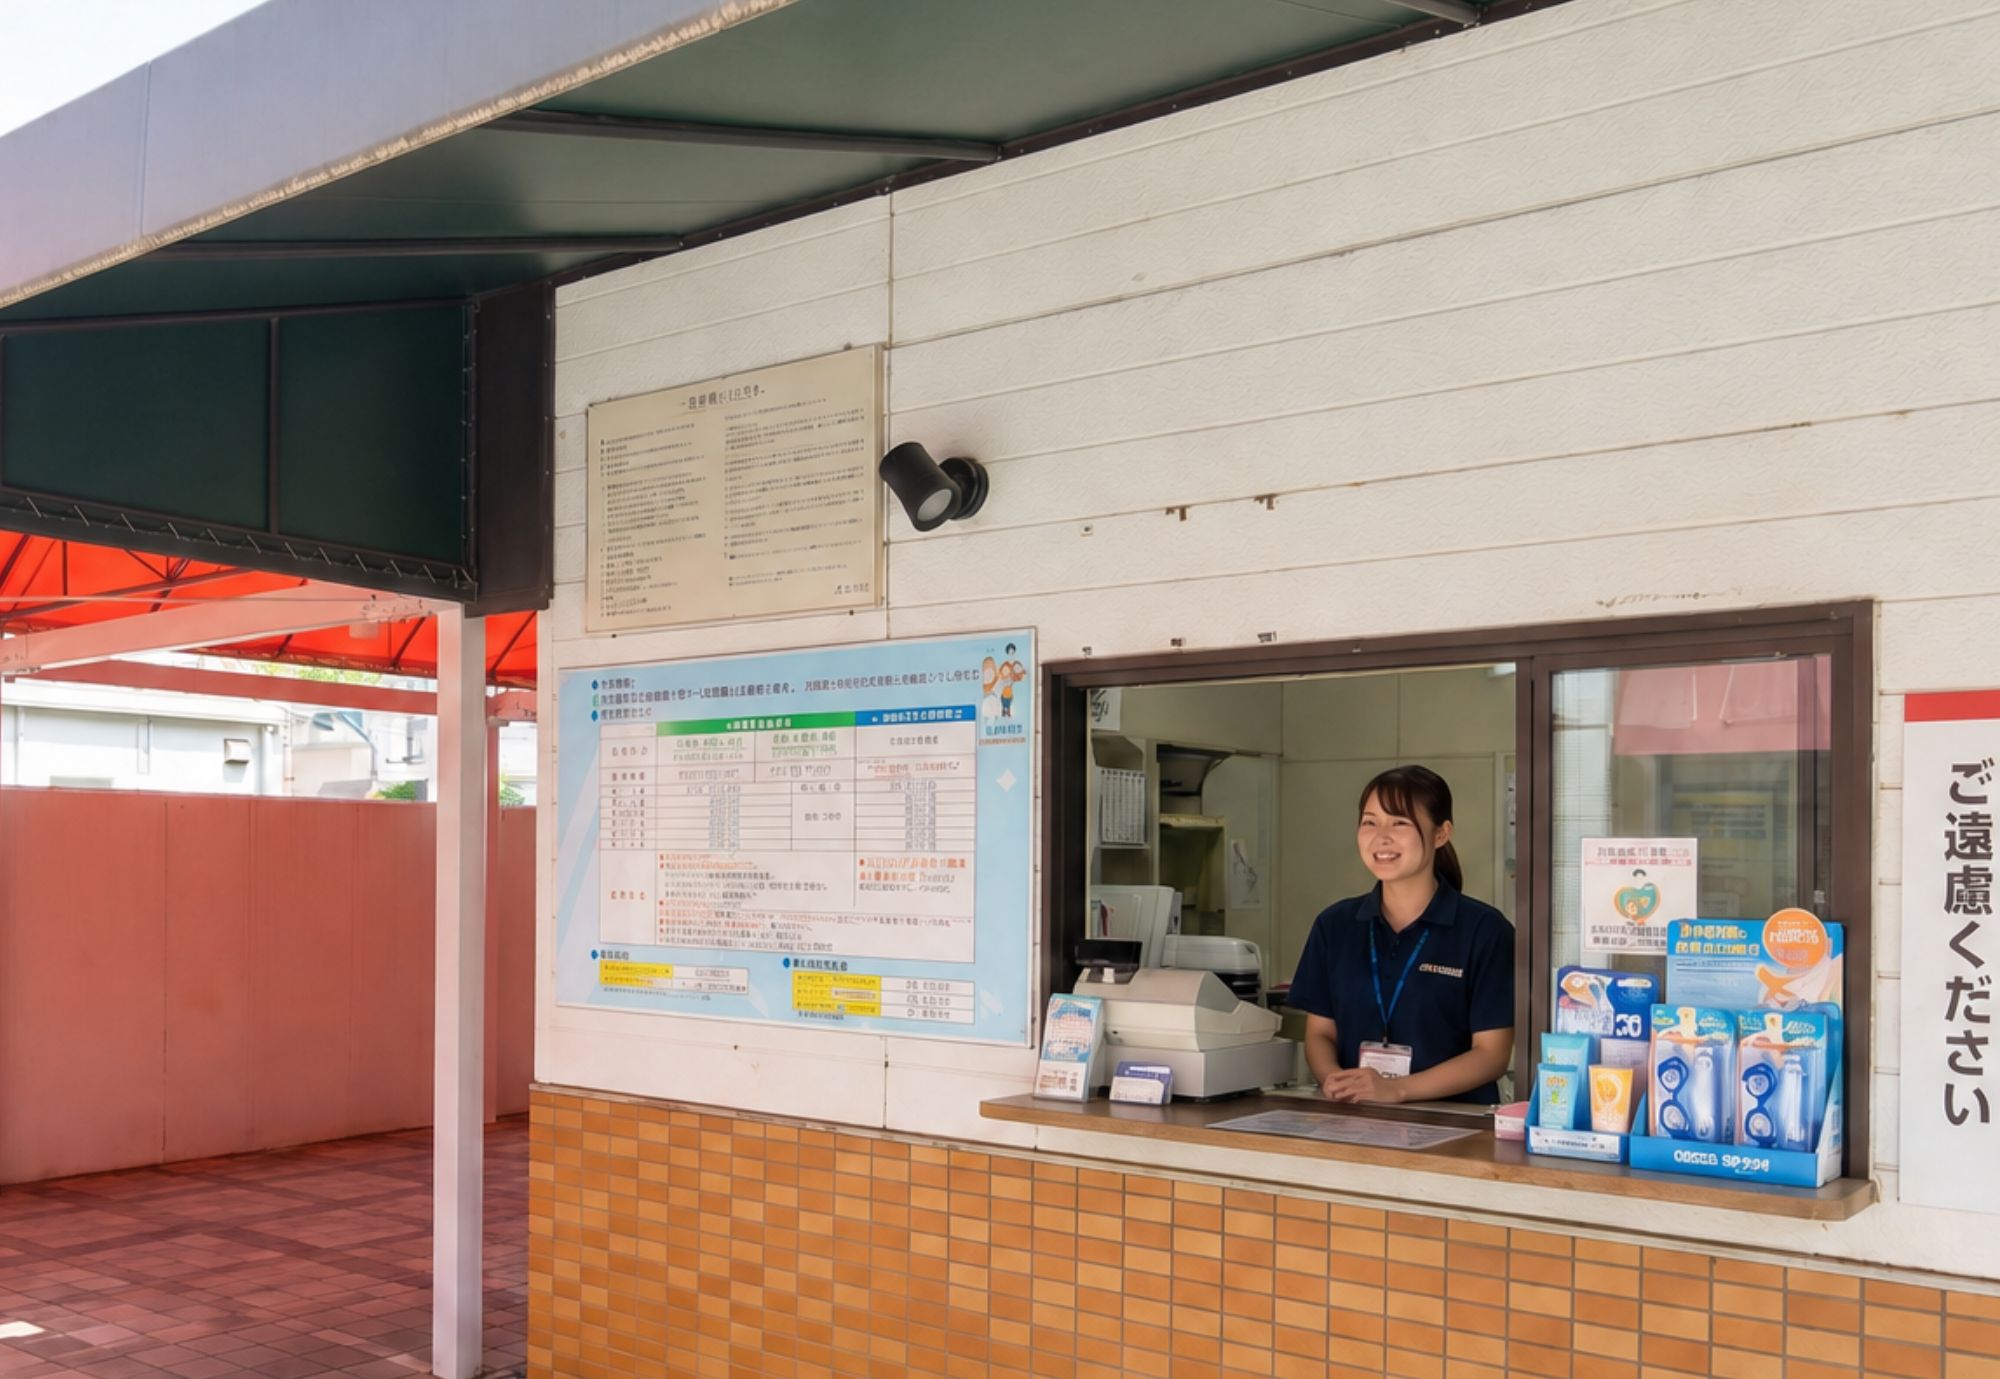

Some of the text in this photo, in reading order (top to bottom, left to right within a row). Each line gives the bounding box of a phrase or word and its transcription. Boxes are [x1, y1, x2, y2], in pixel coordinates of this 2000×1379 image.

[1943, 757, 1995, 1126] ご遠慮ください
